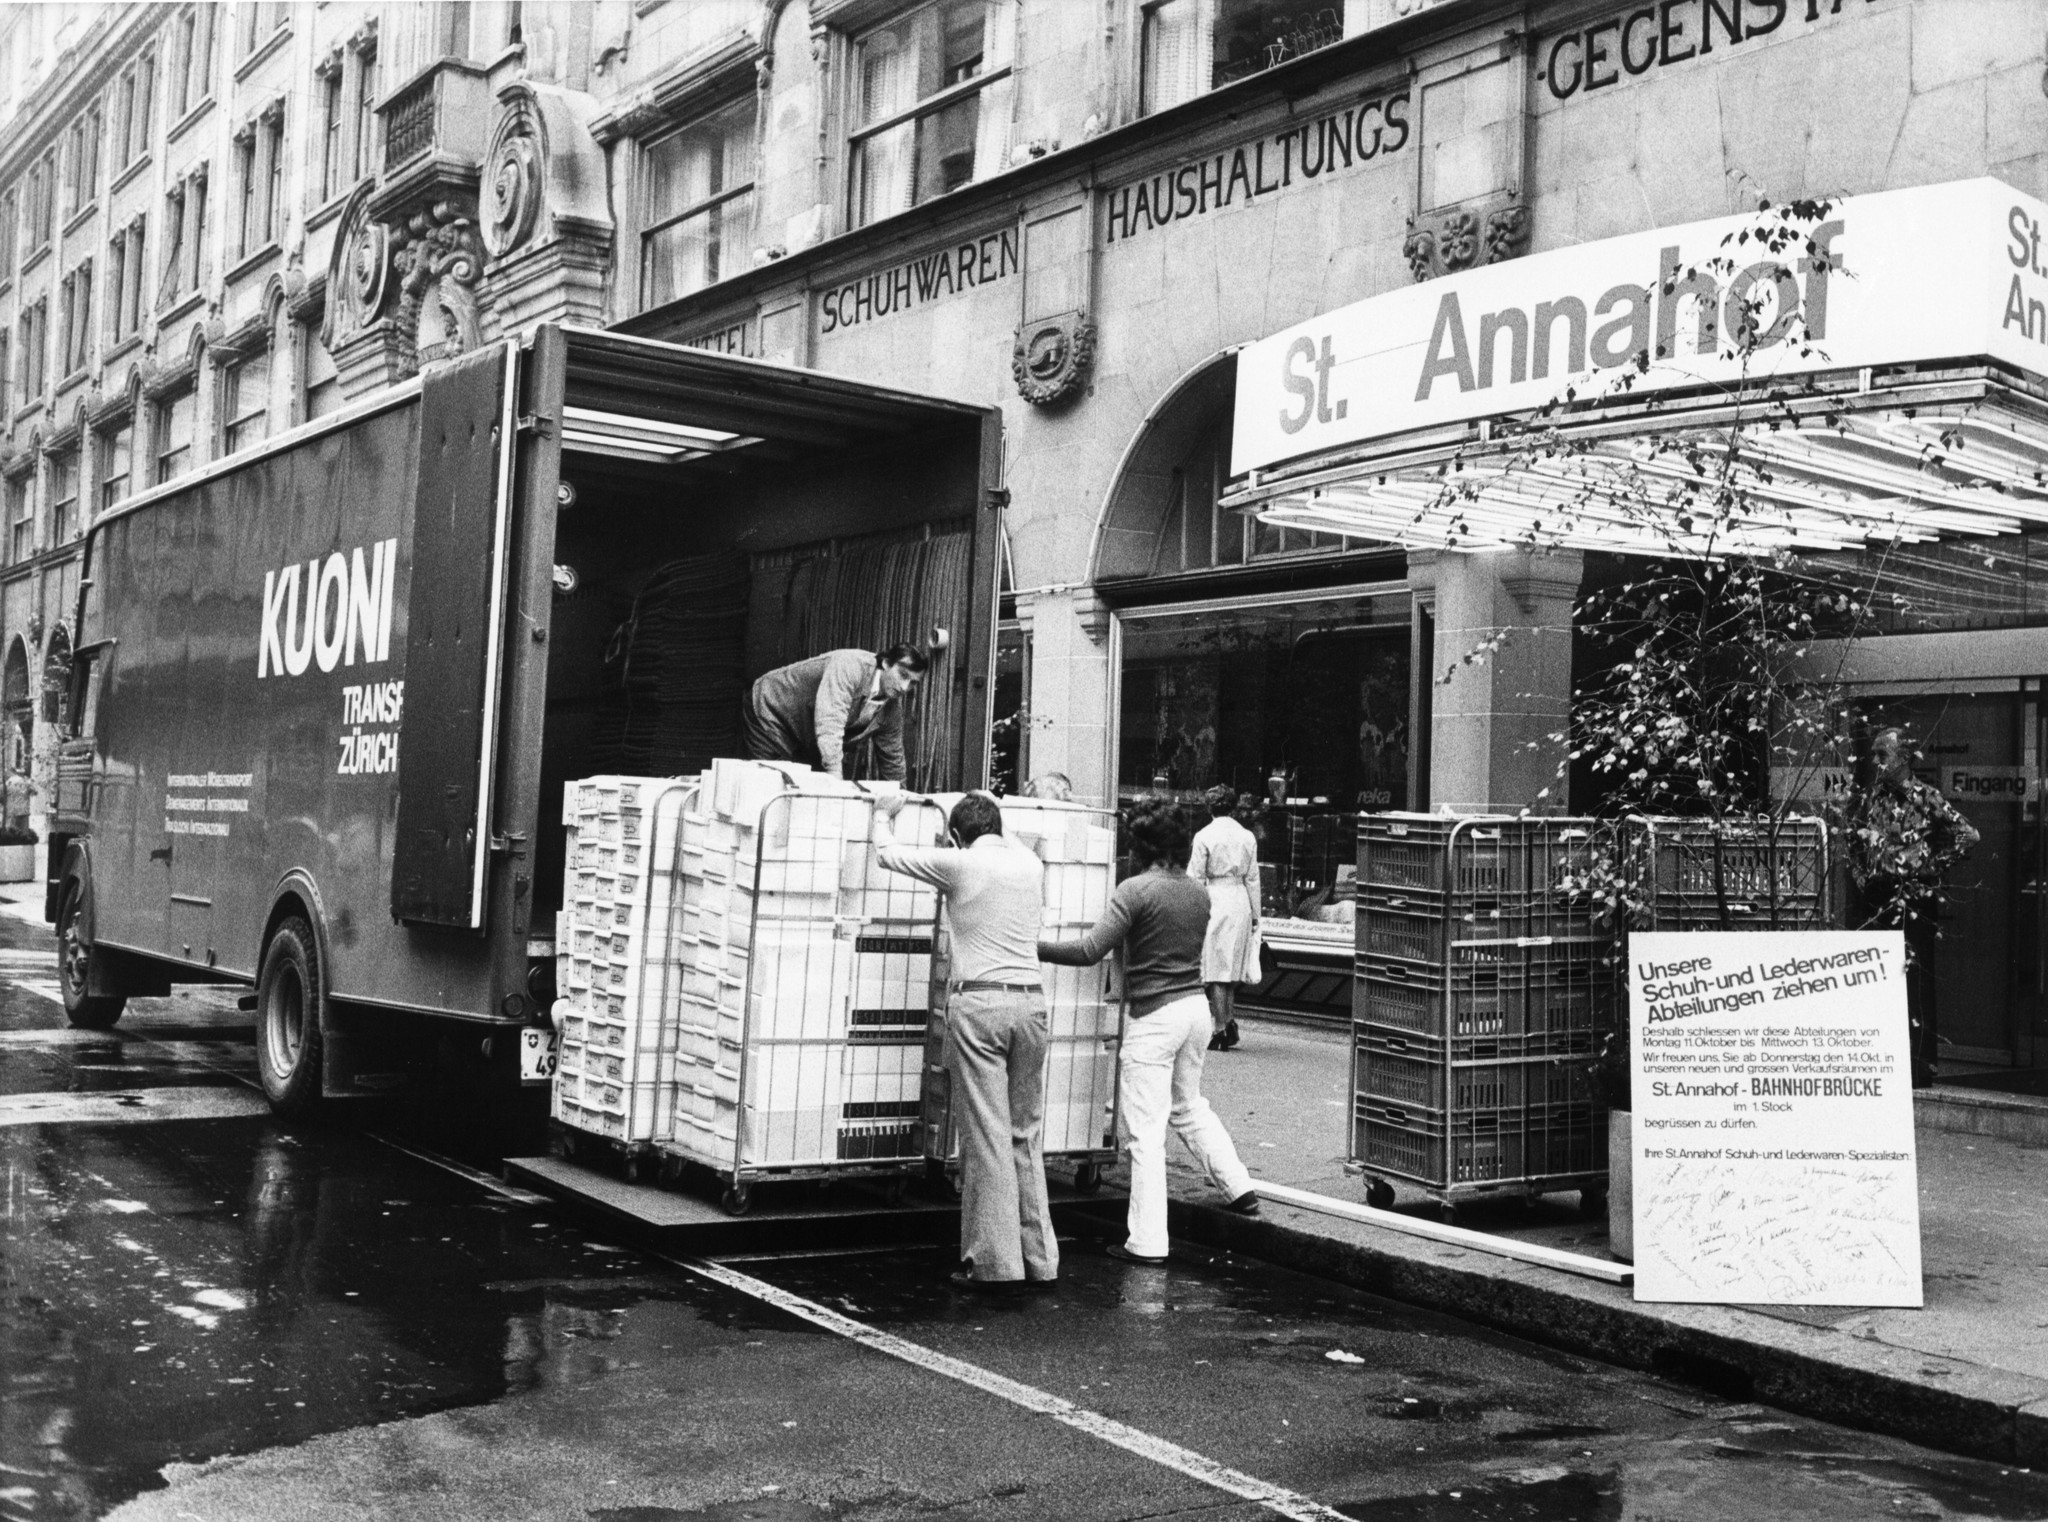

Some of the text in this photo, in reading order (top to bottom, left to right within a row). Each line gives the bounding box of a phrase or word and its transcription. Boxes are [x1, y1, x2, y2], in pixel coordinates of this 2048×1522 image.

[1106, 91, 1411, 244] HAUSHALTUNGS
[821, 227, 1020, 334] SCHUHWAREN
[1278, 218, 1846, 436] St. Annahof
[257, 537, 397, 678] KUONI
[337, 726, 399, 775] ZÜRICH
[1952, 772, 2027, 796] Eingang
[1356, 787, 1391, 804] reka
[1638, 957, 1712, 981] Unsere
[1759, 946, 1890, 981] Lederwaren-
[1647, 989, 1765, 1024] Abteilungen
[1771, 975, 1838, 1001] ziehen
[1642, 1026, 1880, 1039] Deshalb schliessen wir diese Abteilungen von
[1642, 1037, 1681, 1048] Montag
[1740, 1037, 1756, 1047] bis
[1761, 1037, 1808, 1047] Mittwoch
[1827, 1037, 1874, 1047] Oktober.
[1642, 1052, 1659, 1062] Wir
[1662, 1052, 1696, 1062] freuen
[1722, 1052, 1739, 1063] Sie
[1743, 1052, 1757, 1062] ab
[1760, 1052, 1820, 1064] Donnerstag
[1823, 1053, 1843, 1063] den
[1884, 1052, 1894, 1062] in
[1643, 1063, 1893, 1075] unseren neuen und grossen Verkaufsräumen im
[1751, 1076, 1883, 1097] BAHNHOFBRÜCKE
[1733, 1101, 1747, 1112] im
[1761, 1101, 1793, 1112] Stock
[1644, 1118, 1758, 1130] begrüssen zu dürfen.
[1644, 1148, 1663, 1158] Ihre
